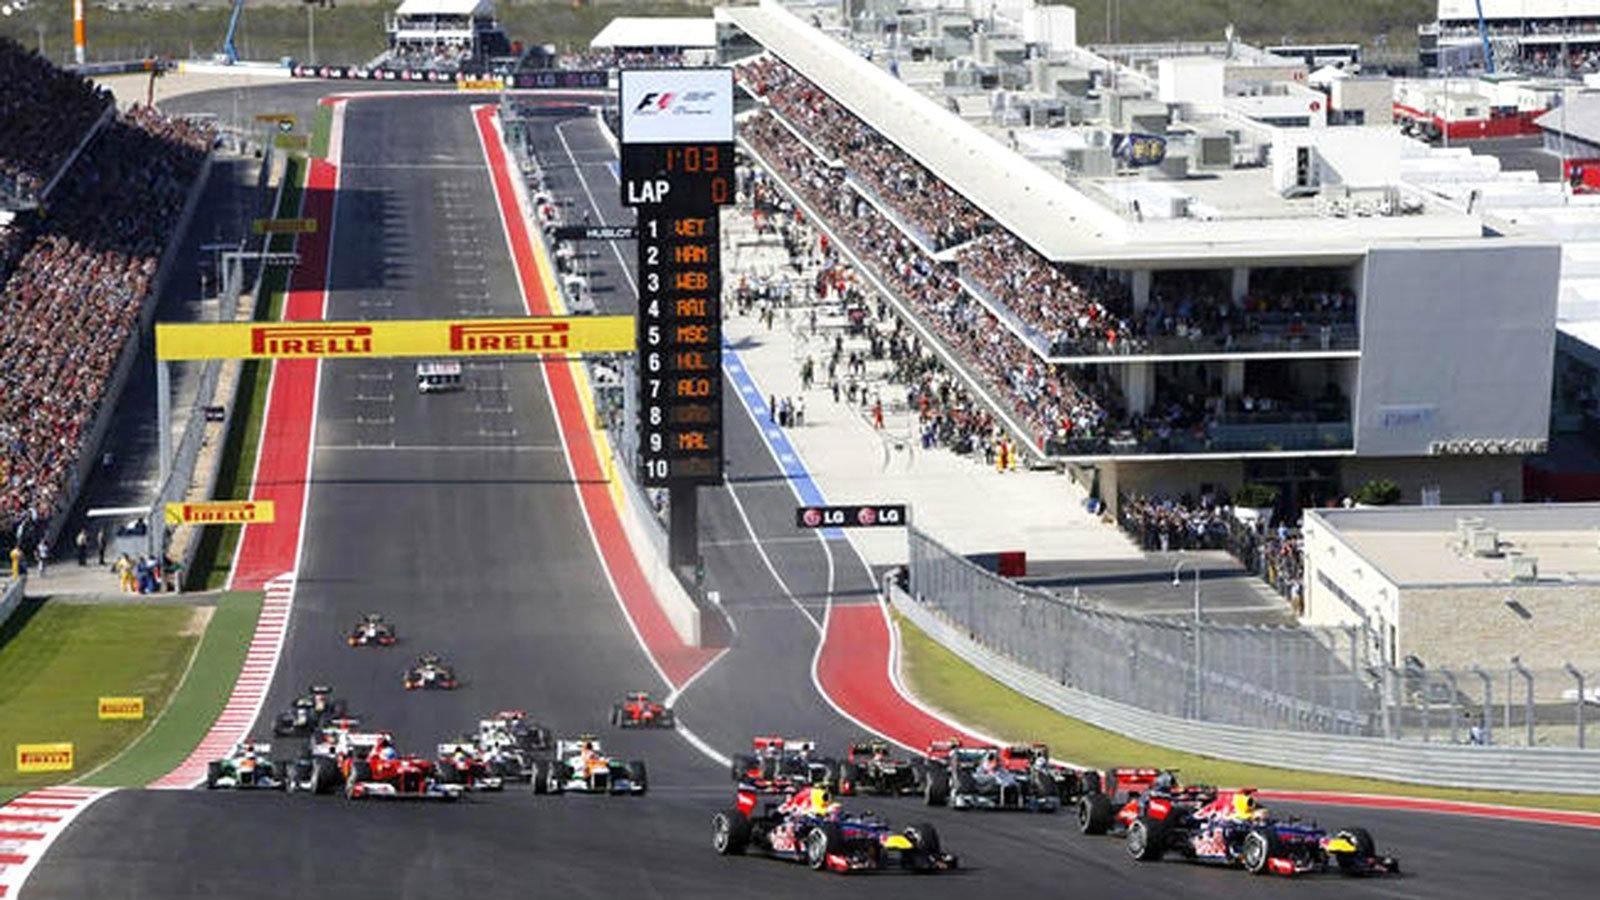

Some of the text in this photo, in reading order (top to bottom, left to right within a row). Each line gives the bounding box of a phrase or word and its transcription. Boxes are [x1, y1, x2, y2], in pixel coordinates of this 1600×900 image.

[628, 179, 729, 204] LAP 0
[648, 219, 706, 238] 1 VET
[647, 245, 708, 265] 2 HAM
[647, 273, 660, 292] 3
[647, 300, 660, 317] 4
[251, 322, 569, 355] PIRELLI PIRELLI
[648, 326, 661, 345] 5
[649, 353, 660, 371] 6
[650, 379, 710, 398] 7 ALO
[649, 406, 662, 425] 8
[650, 433, 662, 452] 9
[645, 460, 668, 477] 10
[183, 504, 255, 522] PIRELLI
[824, 509, 899, 524] LG LG
